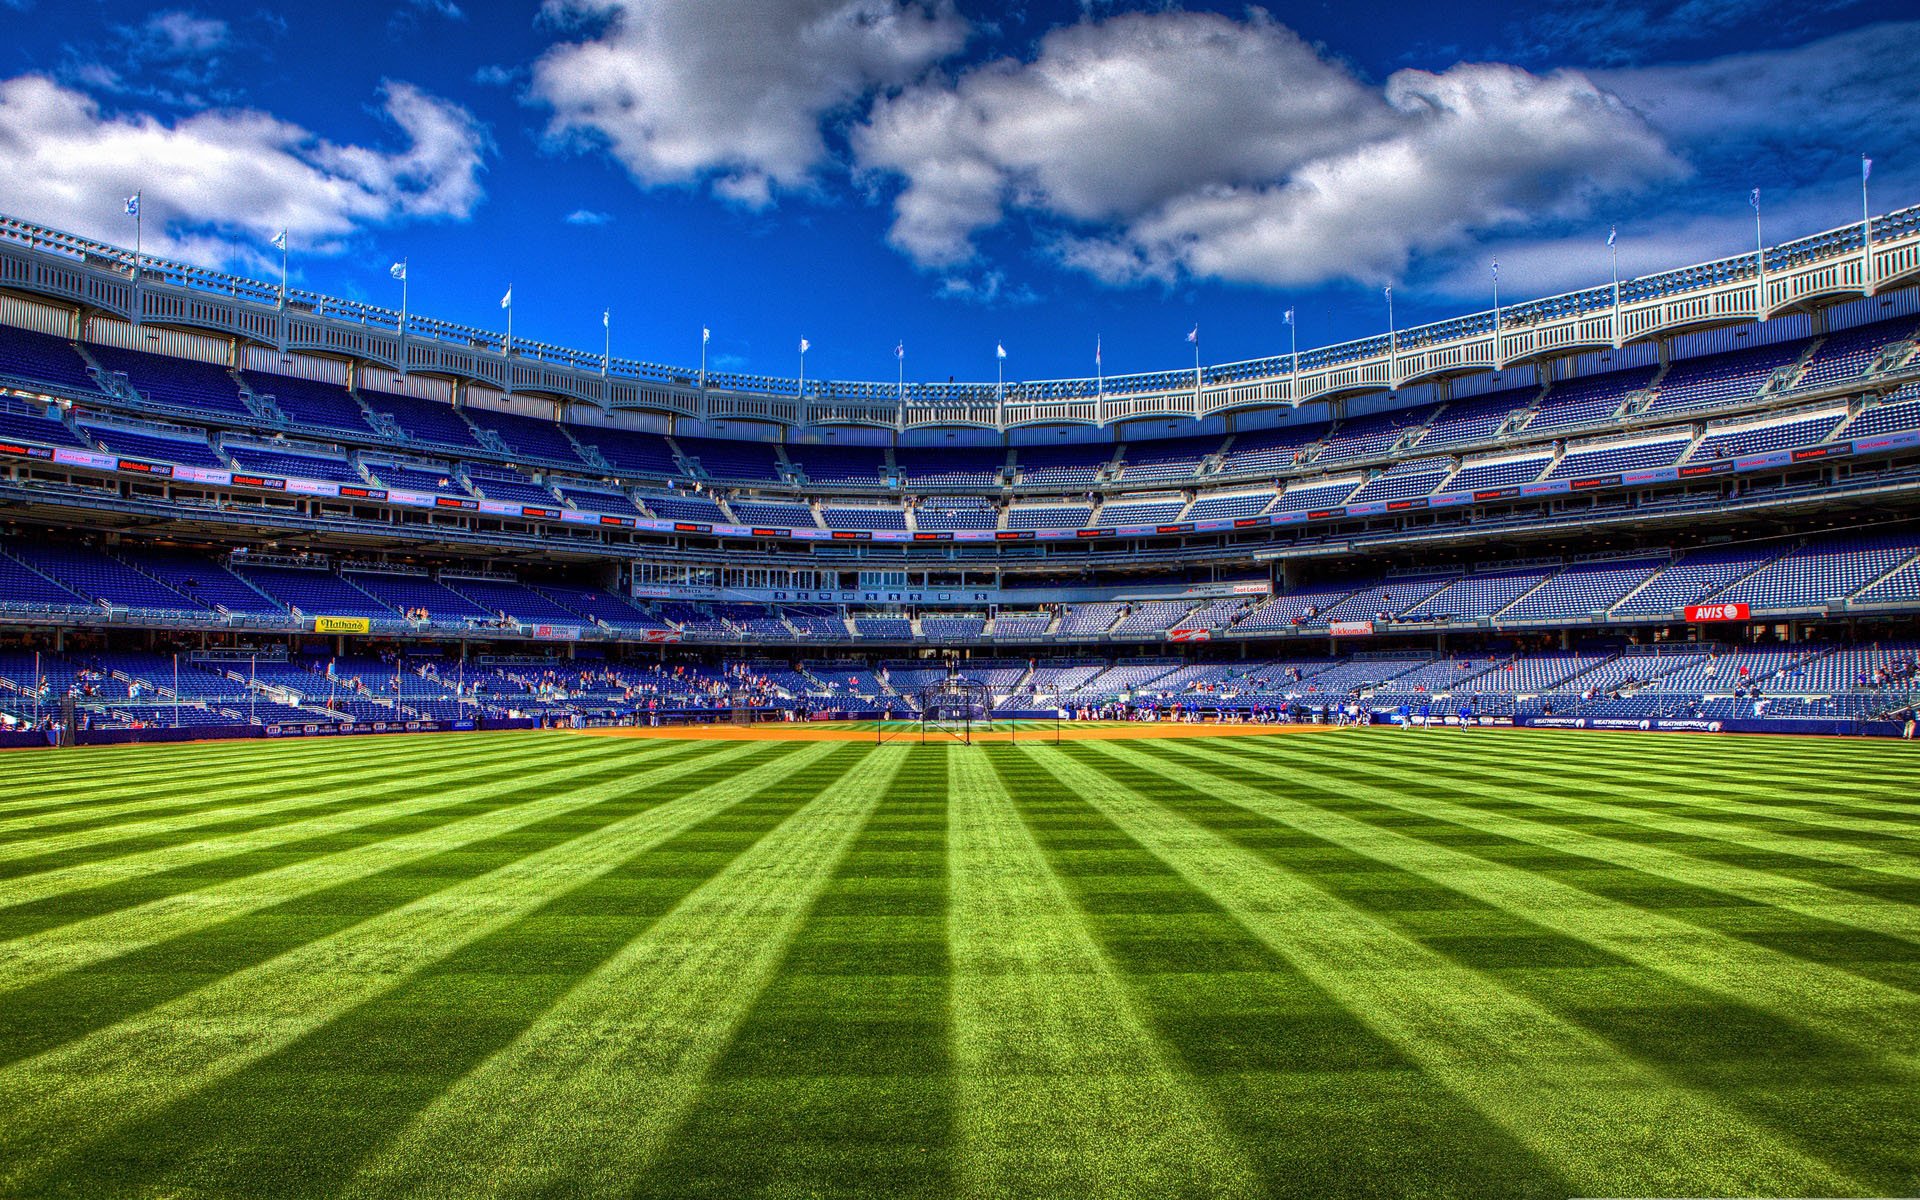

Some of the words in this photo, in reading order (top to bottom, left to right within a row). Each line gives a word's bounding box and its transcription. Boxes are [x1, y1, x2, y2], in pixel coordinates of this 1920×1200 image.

[1696, 607, 1723, 619] AVIS
[321, 618, 364, 630] Nathan's
[1330, 627, 1369, 635] kikkoman
[1657, 720, 1709, 728] WEATHERPROOF
